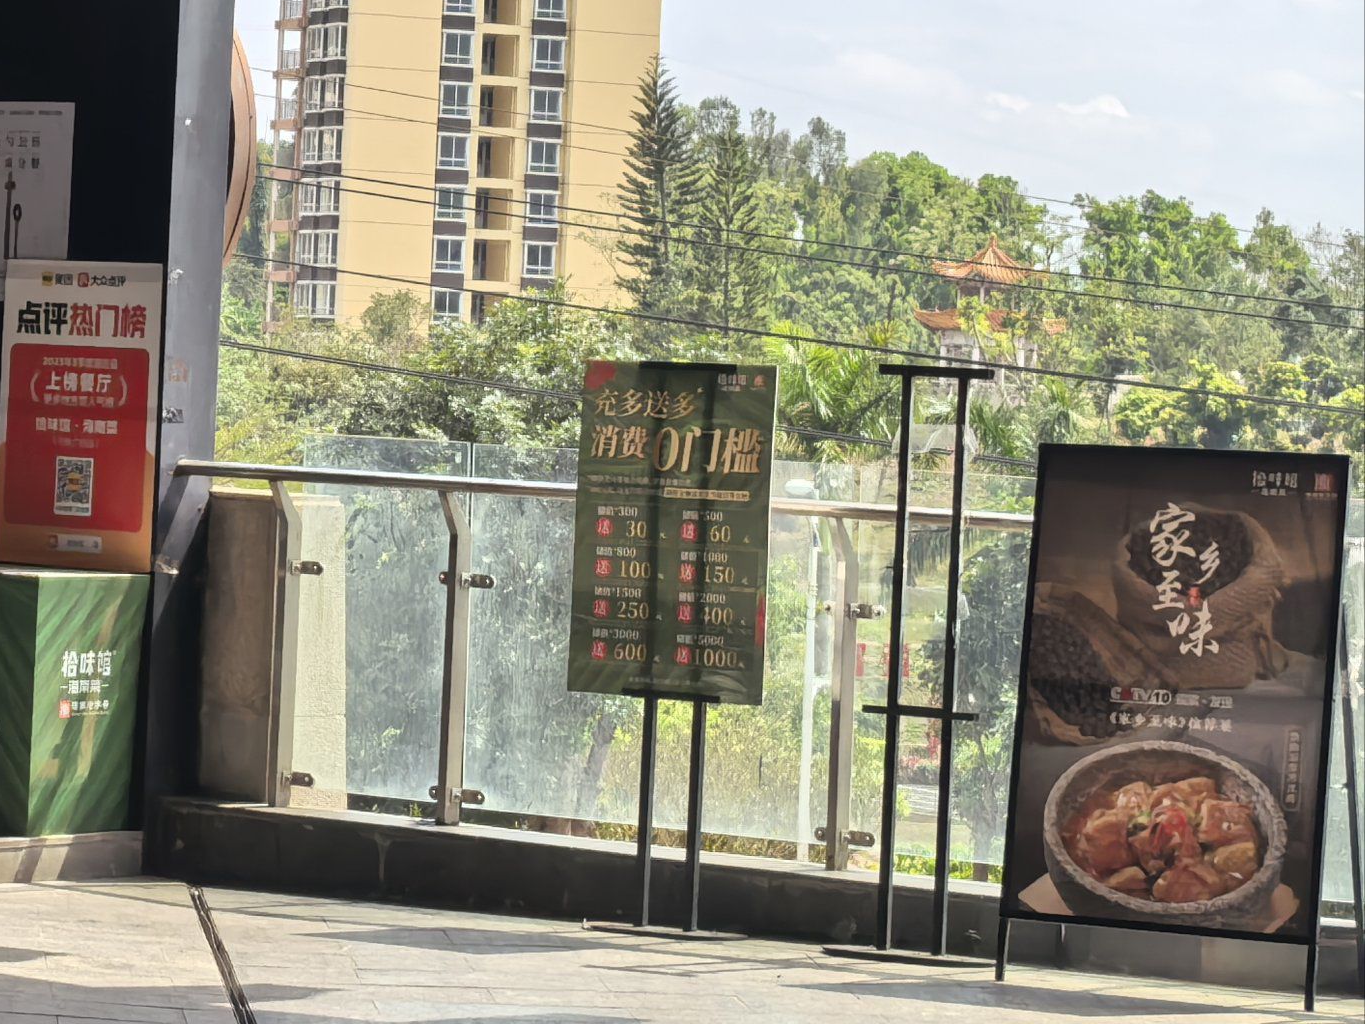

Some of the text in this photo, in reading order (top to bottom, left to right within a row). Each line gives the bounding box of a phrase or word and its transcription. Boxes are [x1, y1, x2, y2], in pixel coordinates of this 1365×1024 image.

[90, 275, 126, 287] 大众点评
[17, 300, 147, 339] 点评热门榜
[625, 519, 647, 538] 30
[710, 524, 731, 543] 60
[620, 560, 651, 579] 100
[705, 564, 734, 584] 150
[1149, 502, 1221, 657] 家乡至味
[617, 601, 649, 620] 250
[614, 643, 647, 661] 600
[695, 648, 738, 668] 1000
[62, 649, 112, 677] 拾味馆
